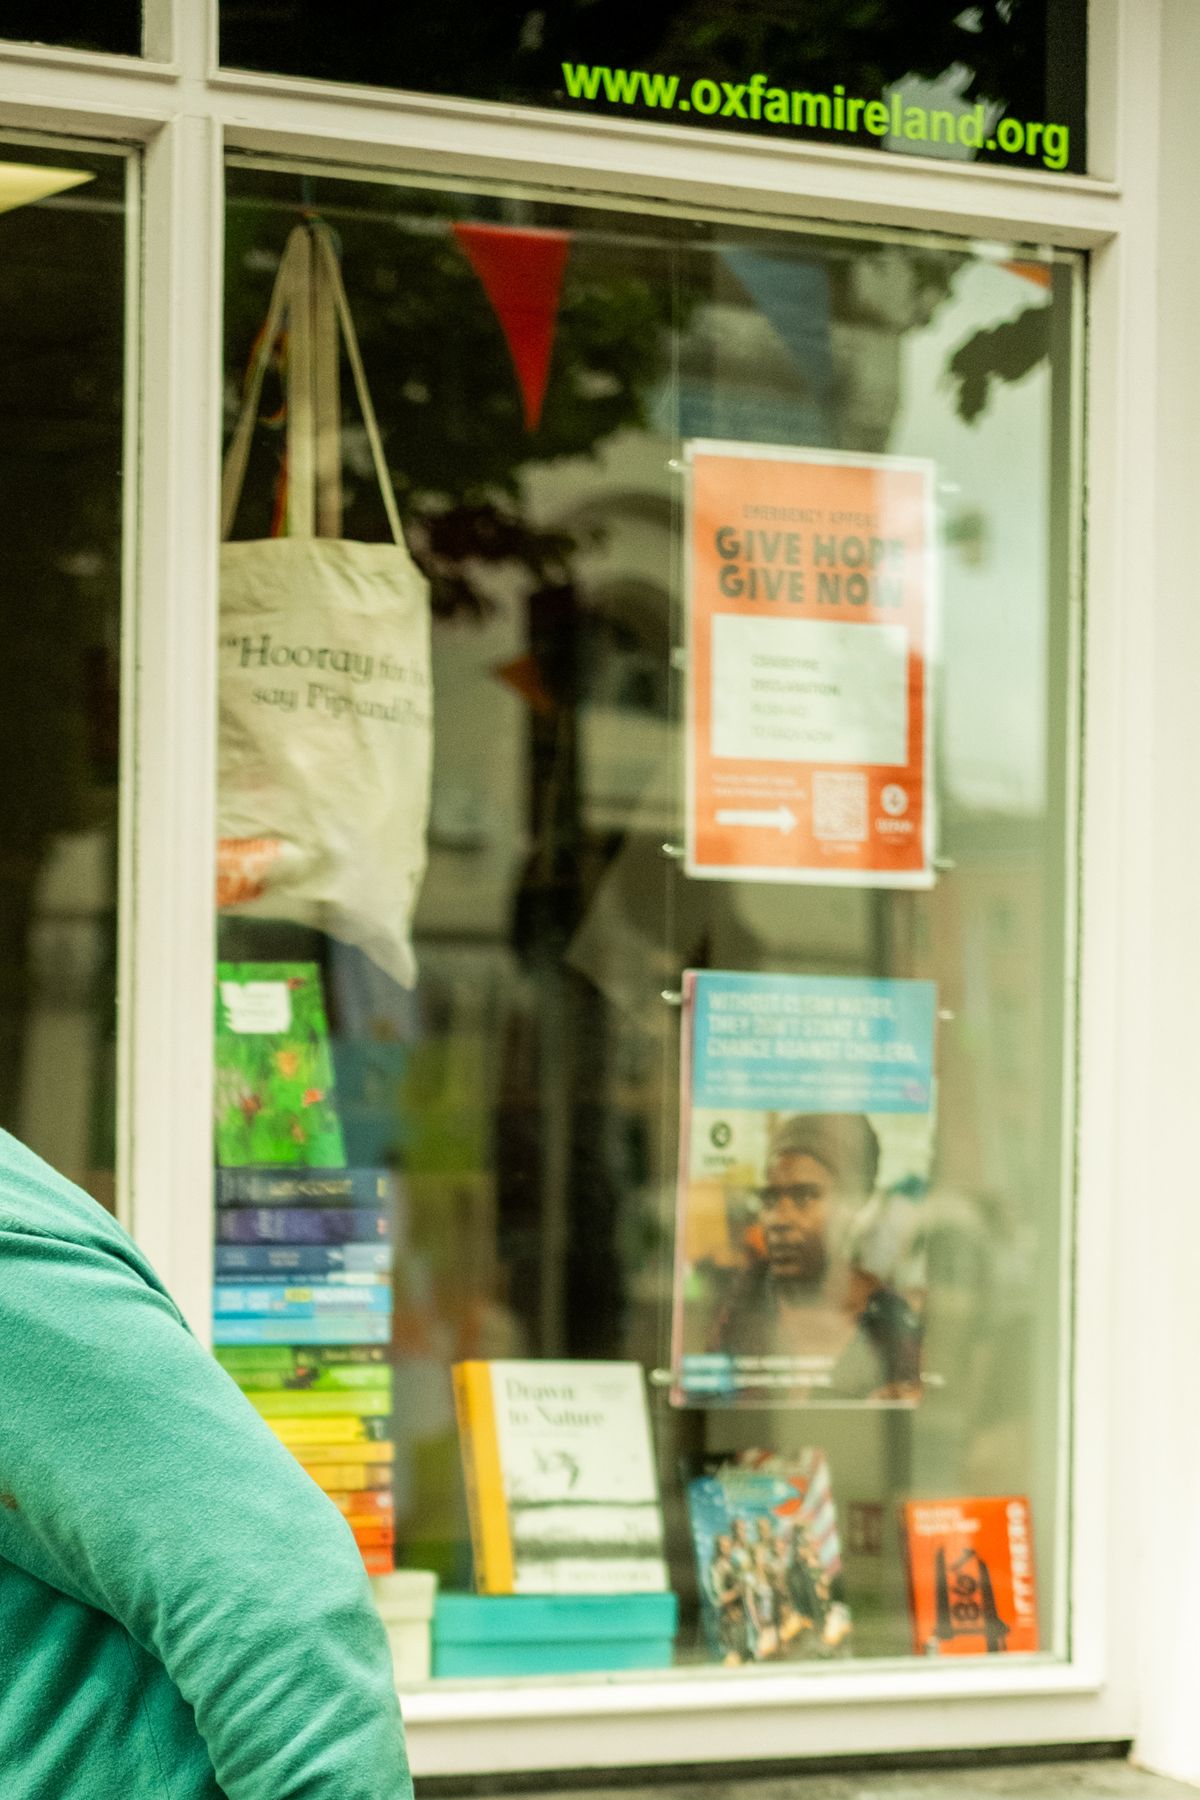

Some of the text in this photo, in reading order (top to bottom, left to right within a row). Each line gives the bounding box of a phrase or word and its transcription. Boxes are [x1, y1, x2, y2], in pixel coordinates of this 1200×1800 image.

[562, 62, 1070, 169] www.oxfamireland.org
[715, 526, 906, 571] GIVE HOPE
[719, 564, 905, 609] GIVE NOW
[252, 687, 299, 713] say
[505, 1377, 575, 1400] Drawn
[509, 1406, 605, 1427] to Nature
